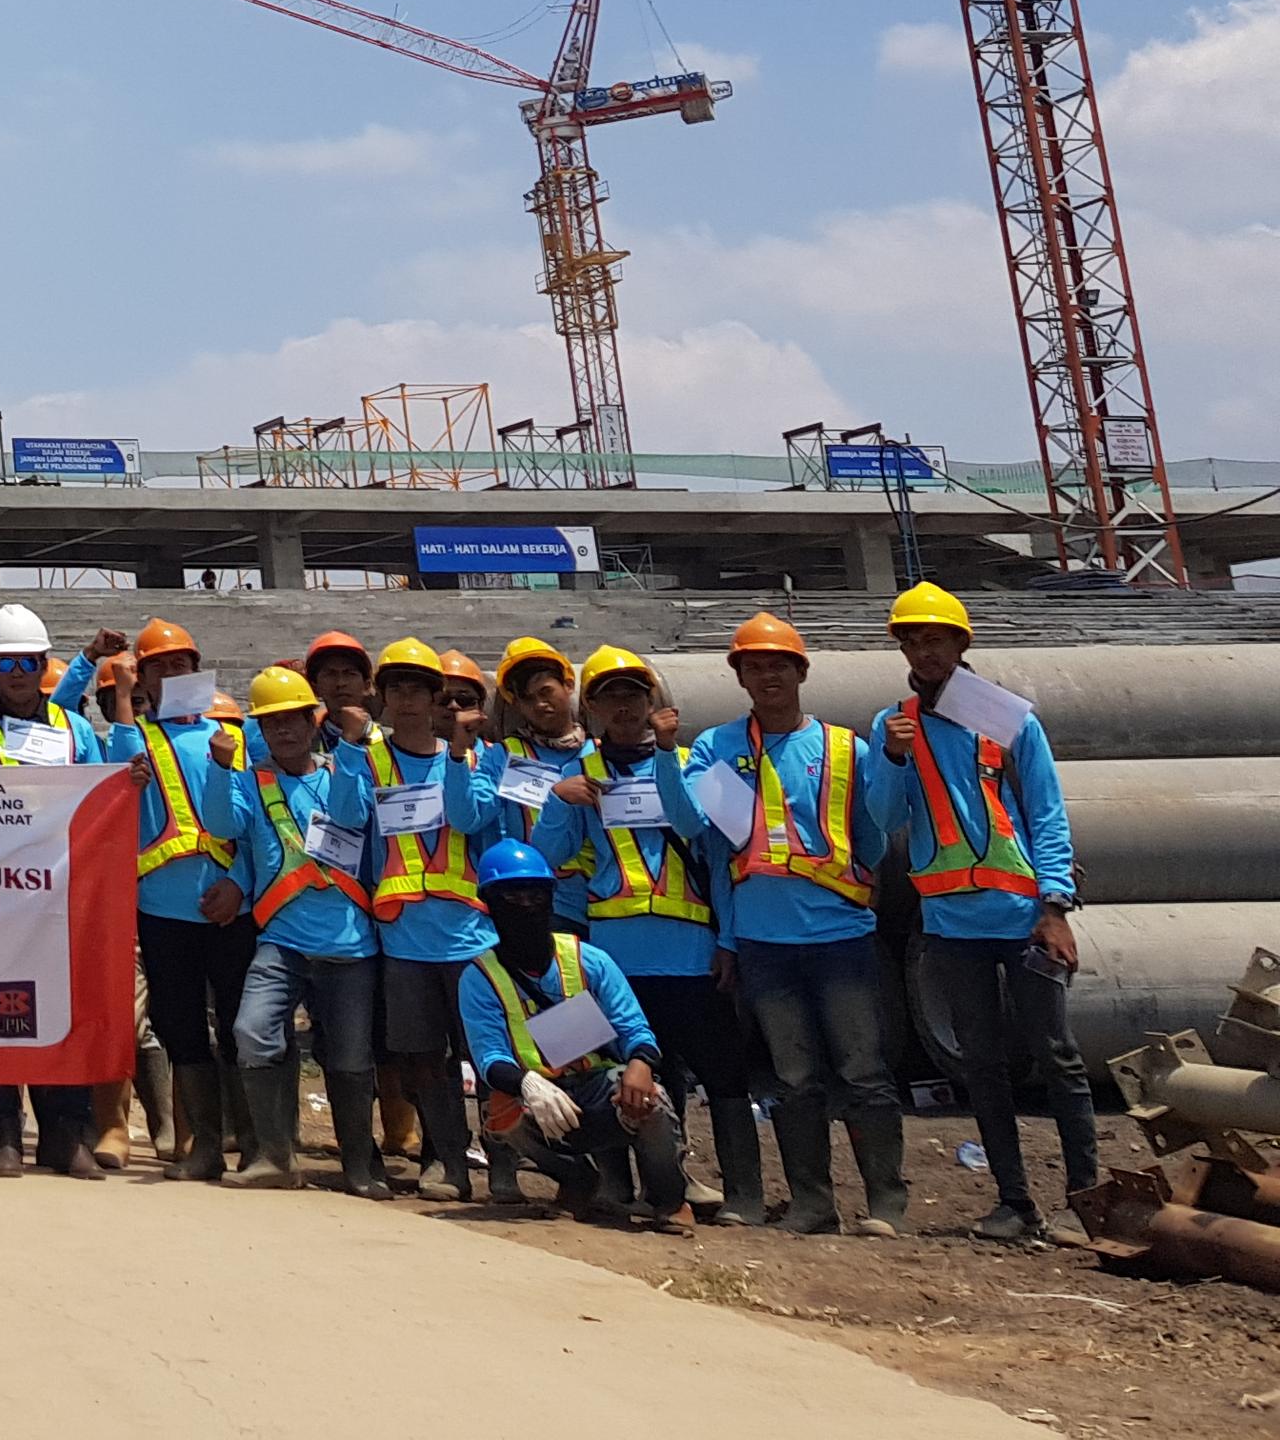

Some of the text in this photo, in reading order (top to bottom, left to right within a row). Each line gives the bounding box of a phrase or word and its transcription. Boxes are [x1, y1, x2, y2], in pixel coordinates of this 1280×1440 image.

[421, 544, 446, 554] HATI
[454, 544, 479, 554] HATI
[482, 544, 520, 554] DALAM
[522, 545, 567, 556] BEKERJA
